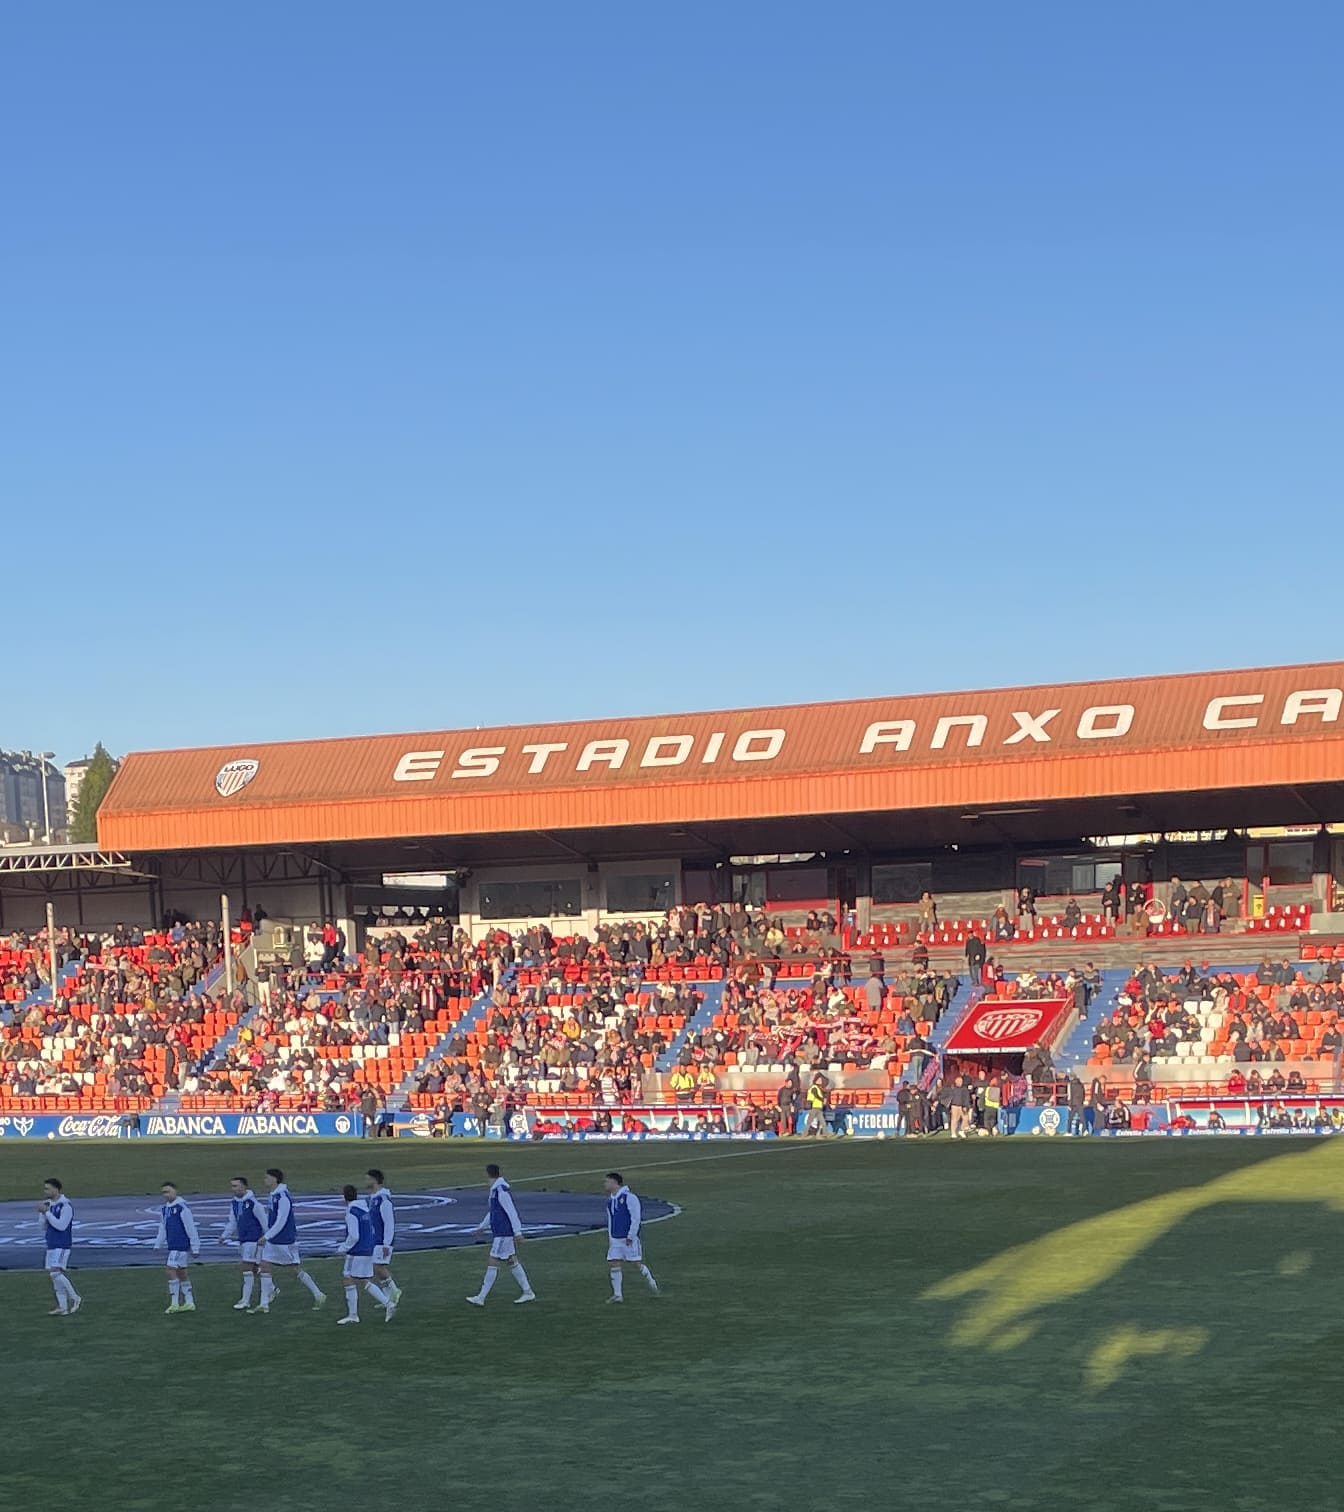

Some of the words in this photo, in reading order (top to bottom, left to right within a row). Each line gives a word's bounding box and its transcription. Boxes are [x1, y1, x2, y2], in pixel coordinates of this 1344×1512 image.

[393, 728, 786, 783] ESTADIO
[858, 704, 1135, 753] ANXO
[156, 1116, 226, 1135] ABANCA
[245, 1115, 319, 1135] ABANCA
